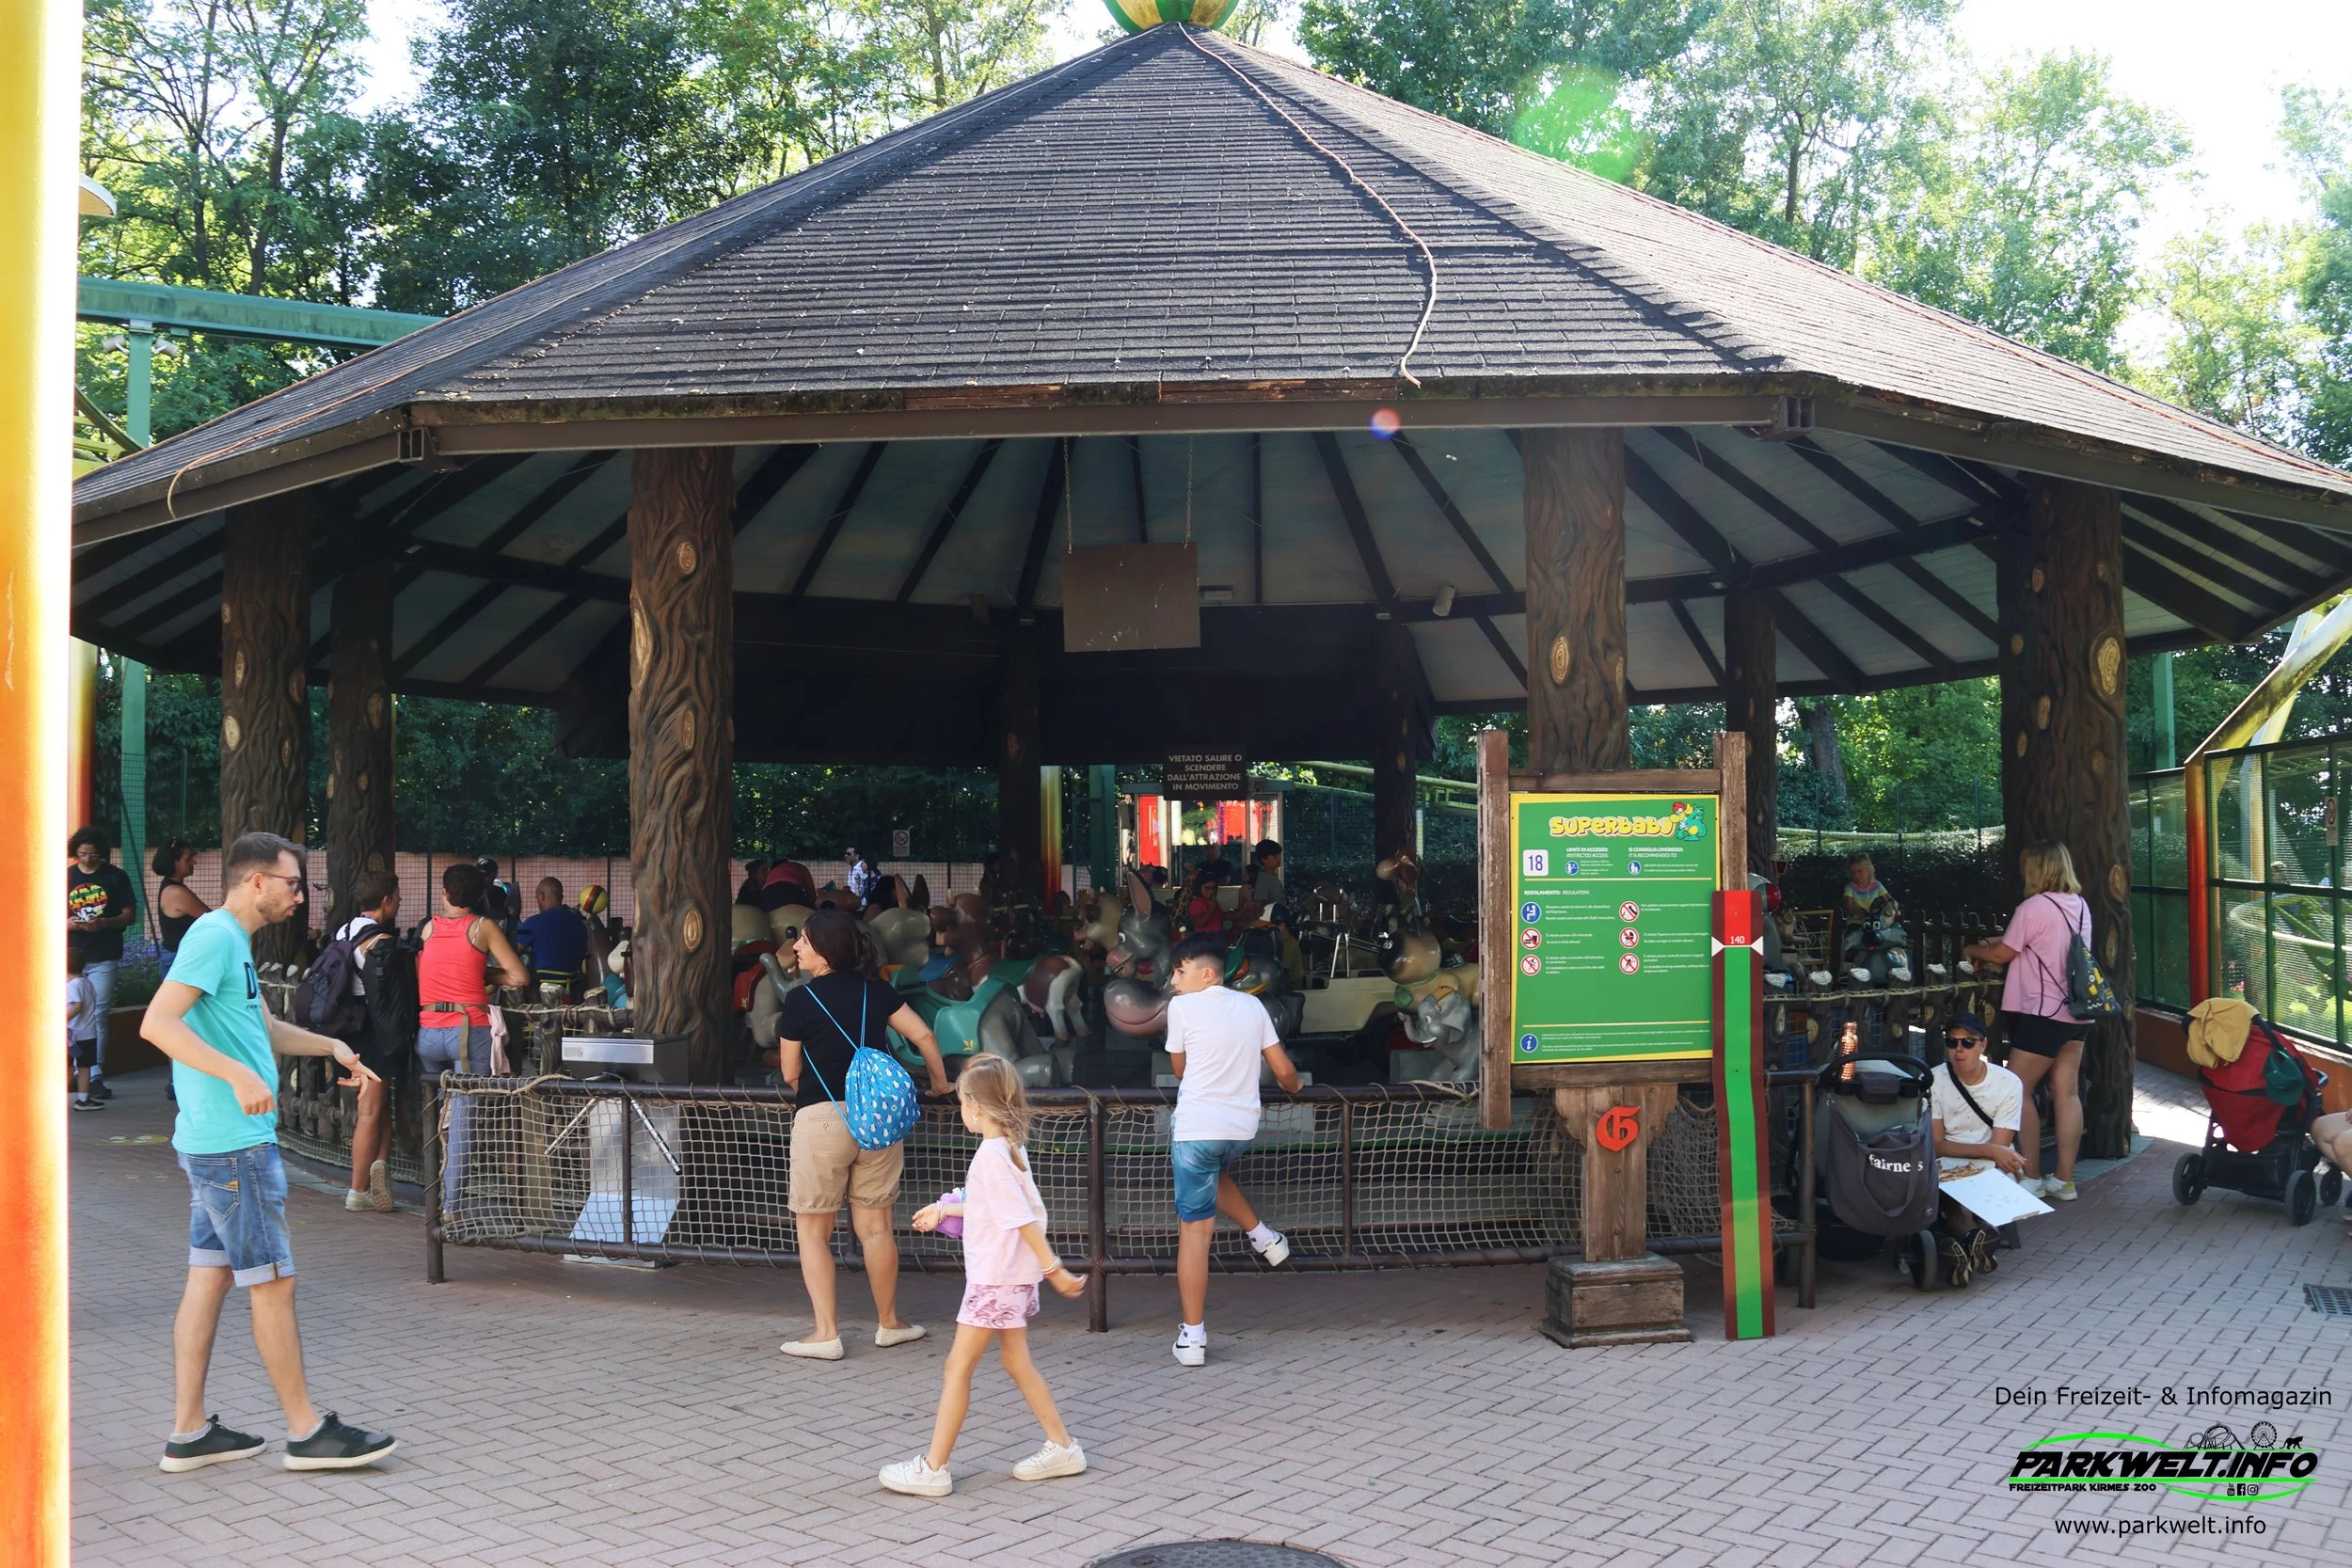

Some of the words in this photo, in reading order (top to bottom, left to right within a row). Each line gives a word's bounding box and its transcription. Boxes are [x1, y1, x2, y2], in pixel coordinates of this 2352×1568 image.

[1168, 754, 1202, 763] VIETATO
[1168, 773, 1241, 782] DALL'ATTRAZIONE
[1528, 854, 1543, 872] 18
[1730, 936, 1745, 944] 140
[1868, 1153, 1924, 1172] fairnes
